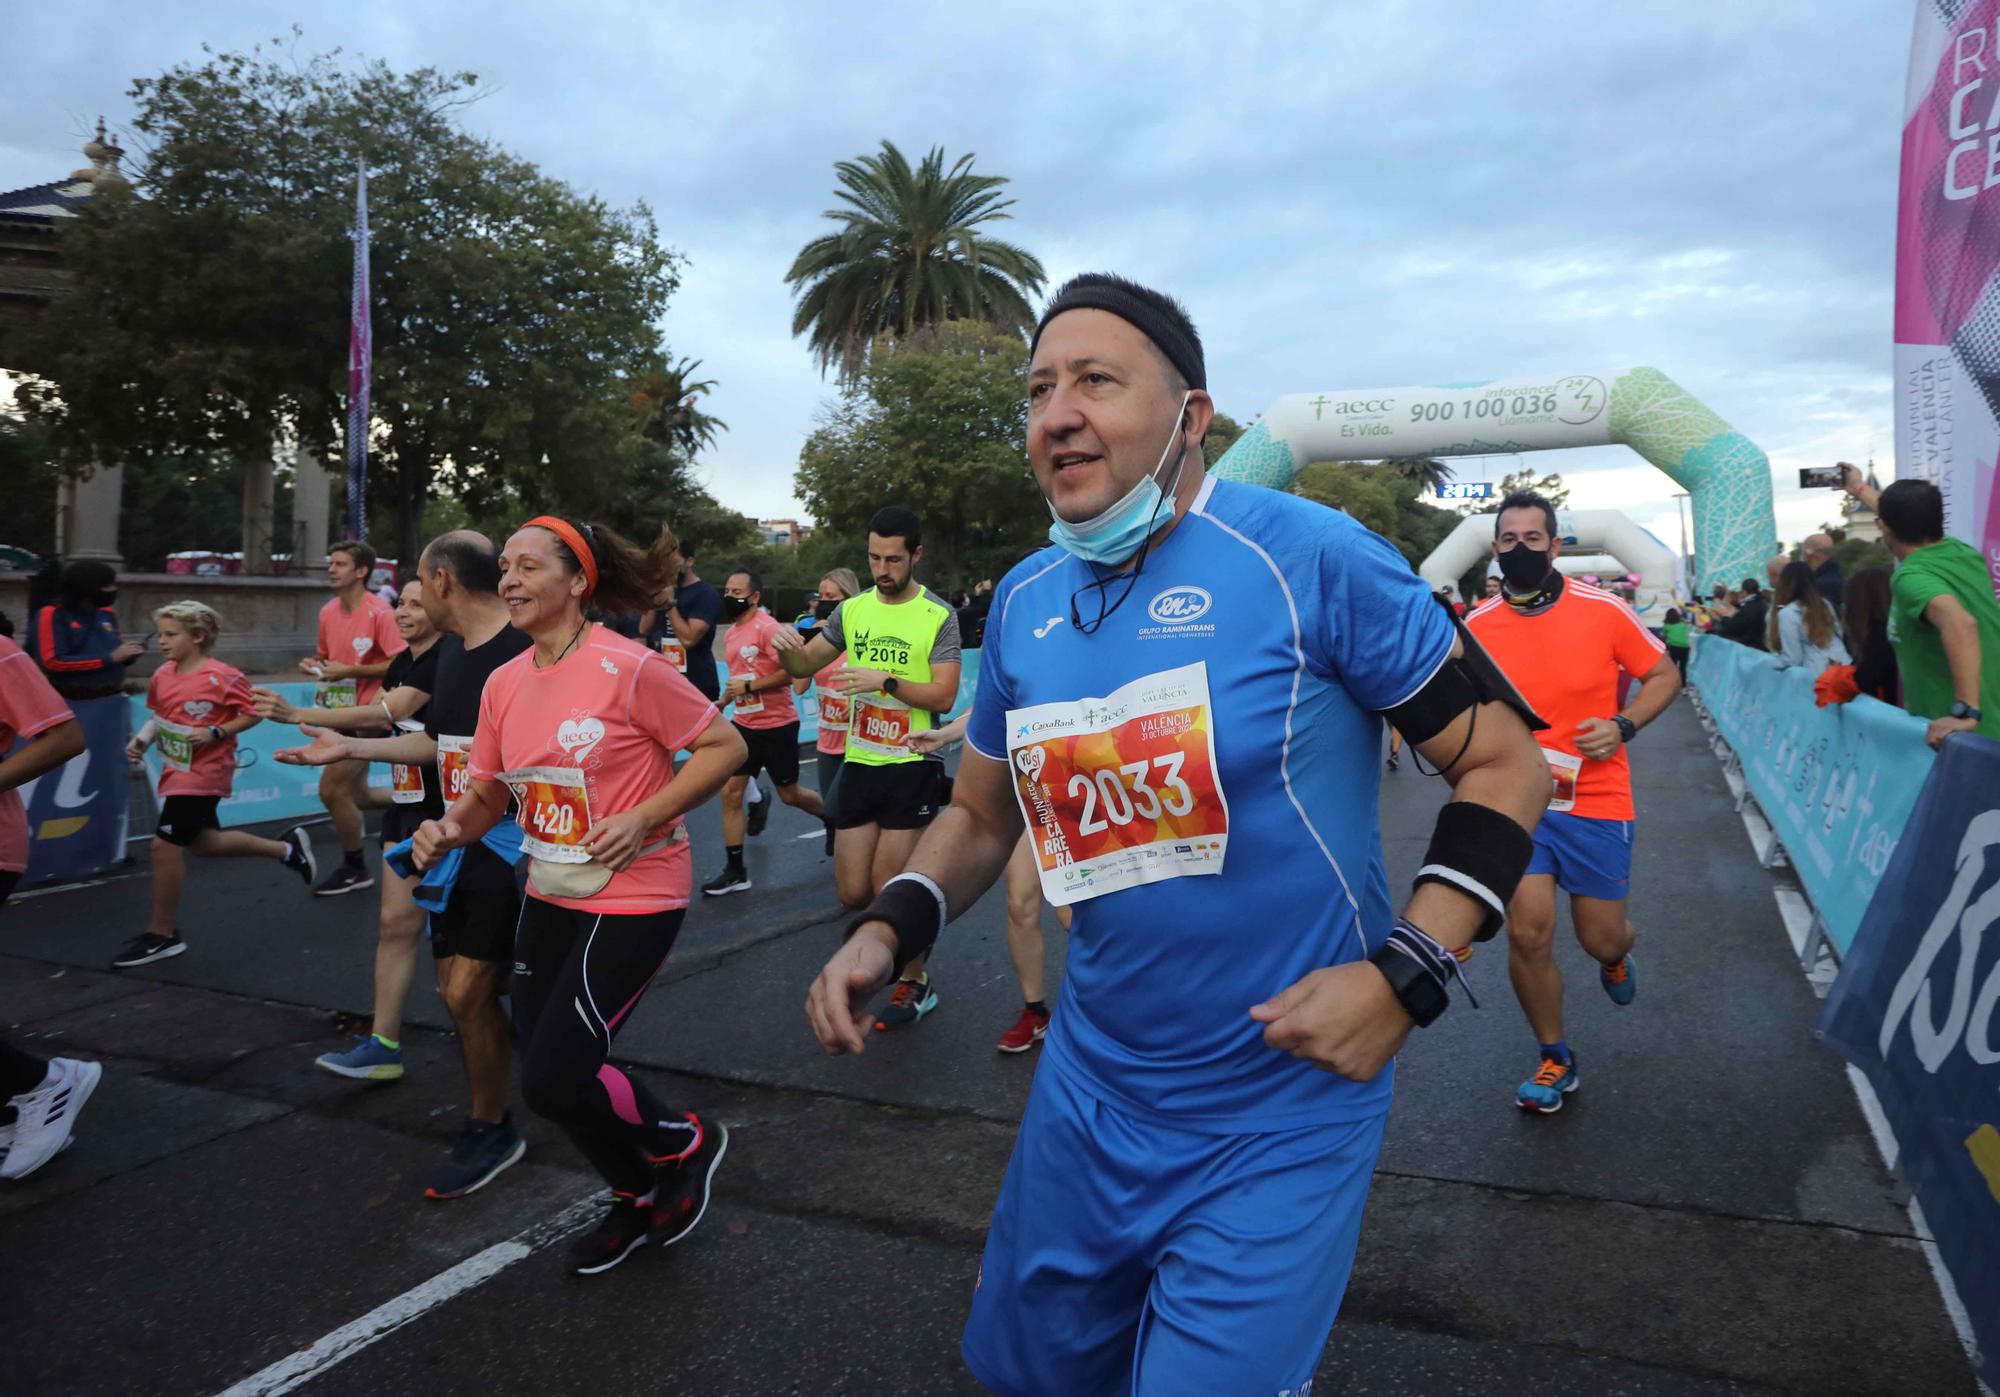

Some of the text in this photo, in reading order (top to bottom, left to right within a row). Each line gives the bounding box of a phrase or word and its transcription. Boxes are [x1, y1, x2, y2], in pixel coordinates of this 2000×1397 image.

[1336, 399, 1396, 414] aecc
[1411, 401, 1454, 423] 900
[1463, 398, 1505, 419] 100
[1511, 394, 1557, 416] 036
[1341, 423, 1393, 437] Es Vida.
[1138, 624, 1216, 635] GRUPO RAMINATRANS
[870, 647, 909, 665] 2018
[866, 716, 900, 740] 1990
[1031, 718, 1076, 732] CaixaBank
[1140, 711, 1192, 732] VALÈNCIA
[561, 728, 600, 744] aecc
[1141, 732, 1149, 741] 31
[1150, 727, 1177, 739] OCTUBRE
[1020, 753, 1032, 767] YO
[1068, 751, 1194, 837] 2033
[533, 802, 574, 835] 420
